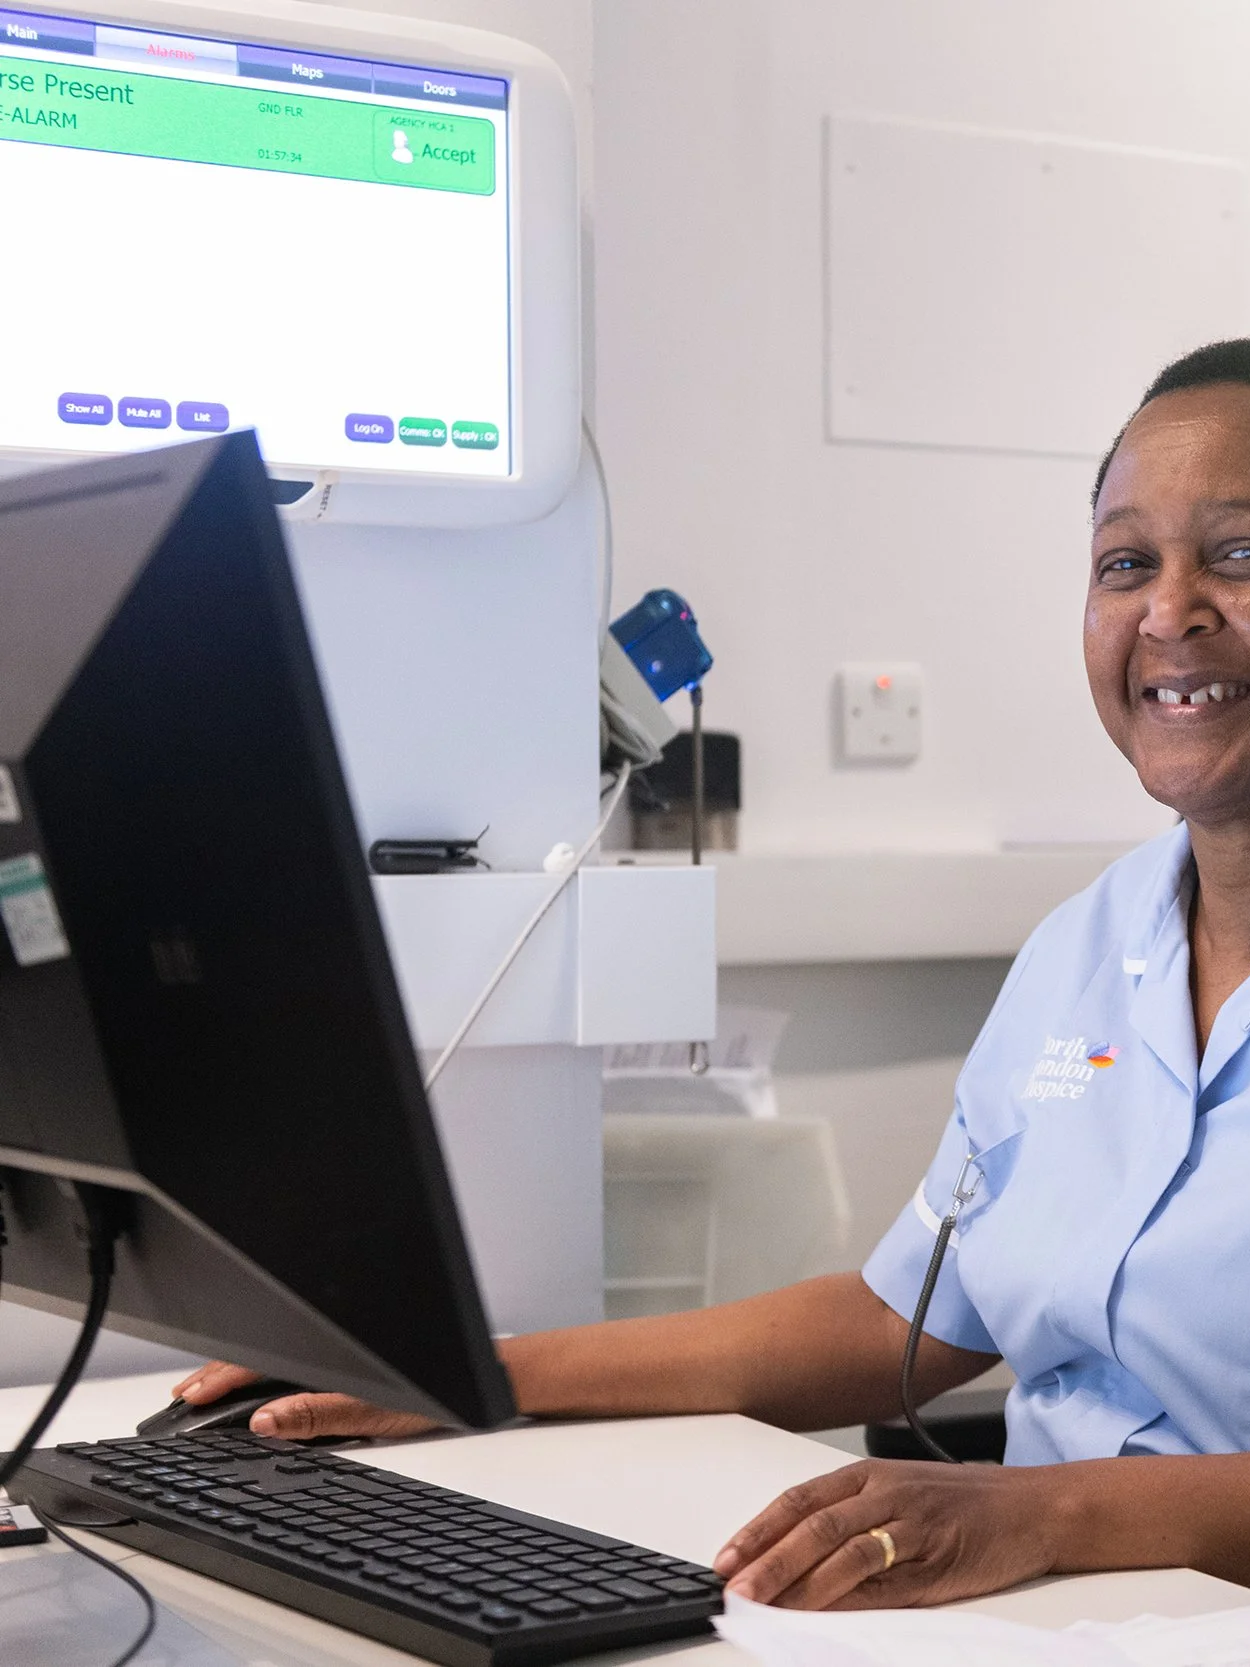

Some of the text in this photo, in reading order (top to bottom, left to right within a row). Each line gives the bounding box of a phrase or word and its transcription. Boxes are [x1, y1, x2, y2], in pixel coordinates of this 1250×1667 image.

[6, 23, 38, 40] Main
[146, 43, 196, 61] Alarms
[291, 63, 324, 80] Maps
[45, 73, 134, 105] Present
[423, 80, 457, 97] Doors
[257, 102, 303, 118] GND FLR
[257, 148, 303, 163] 01:57:34
[421, 143, 476, 165] Accept
[65, 403, 104, 415] Show All
[149, 408, 162, 419] All
[354, 423, 384, 434] Log On
[432, 428, 445, 438] OK
[1043, 1036, 1088, 1060] orth
[1034, 1053, 1095, 1082] ondon
